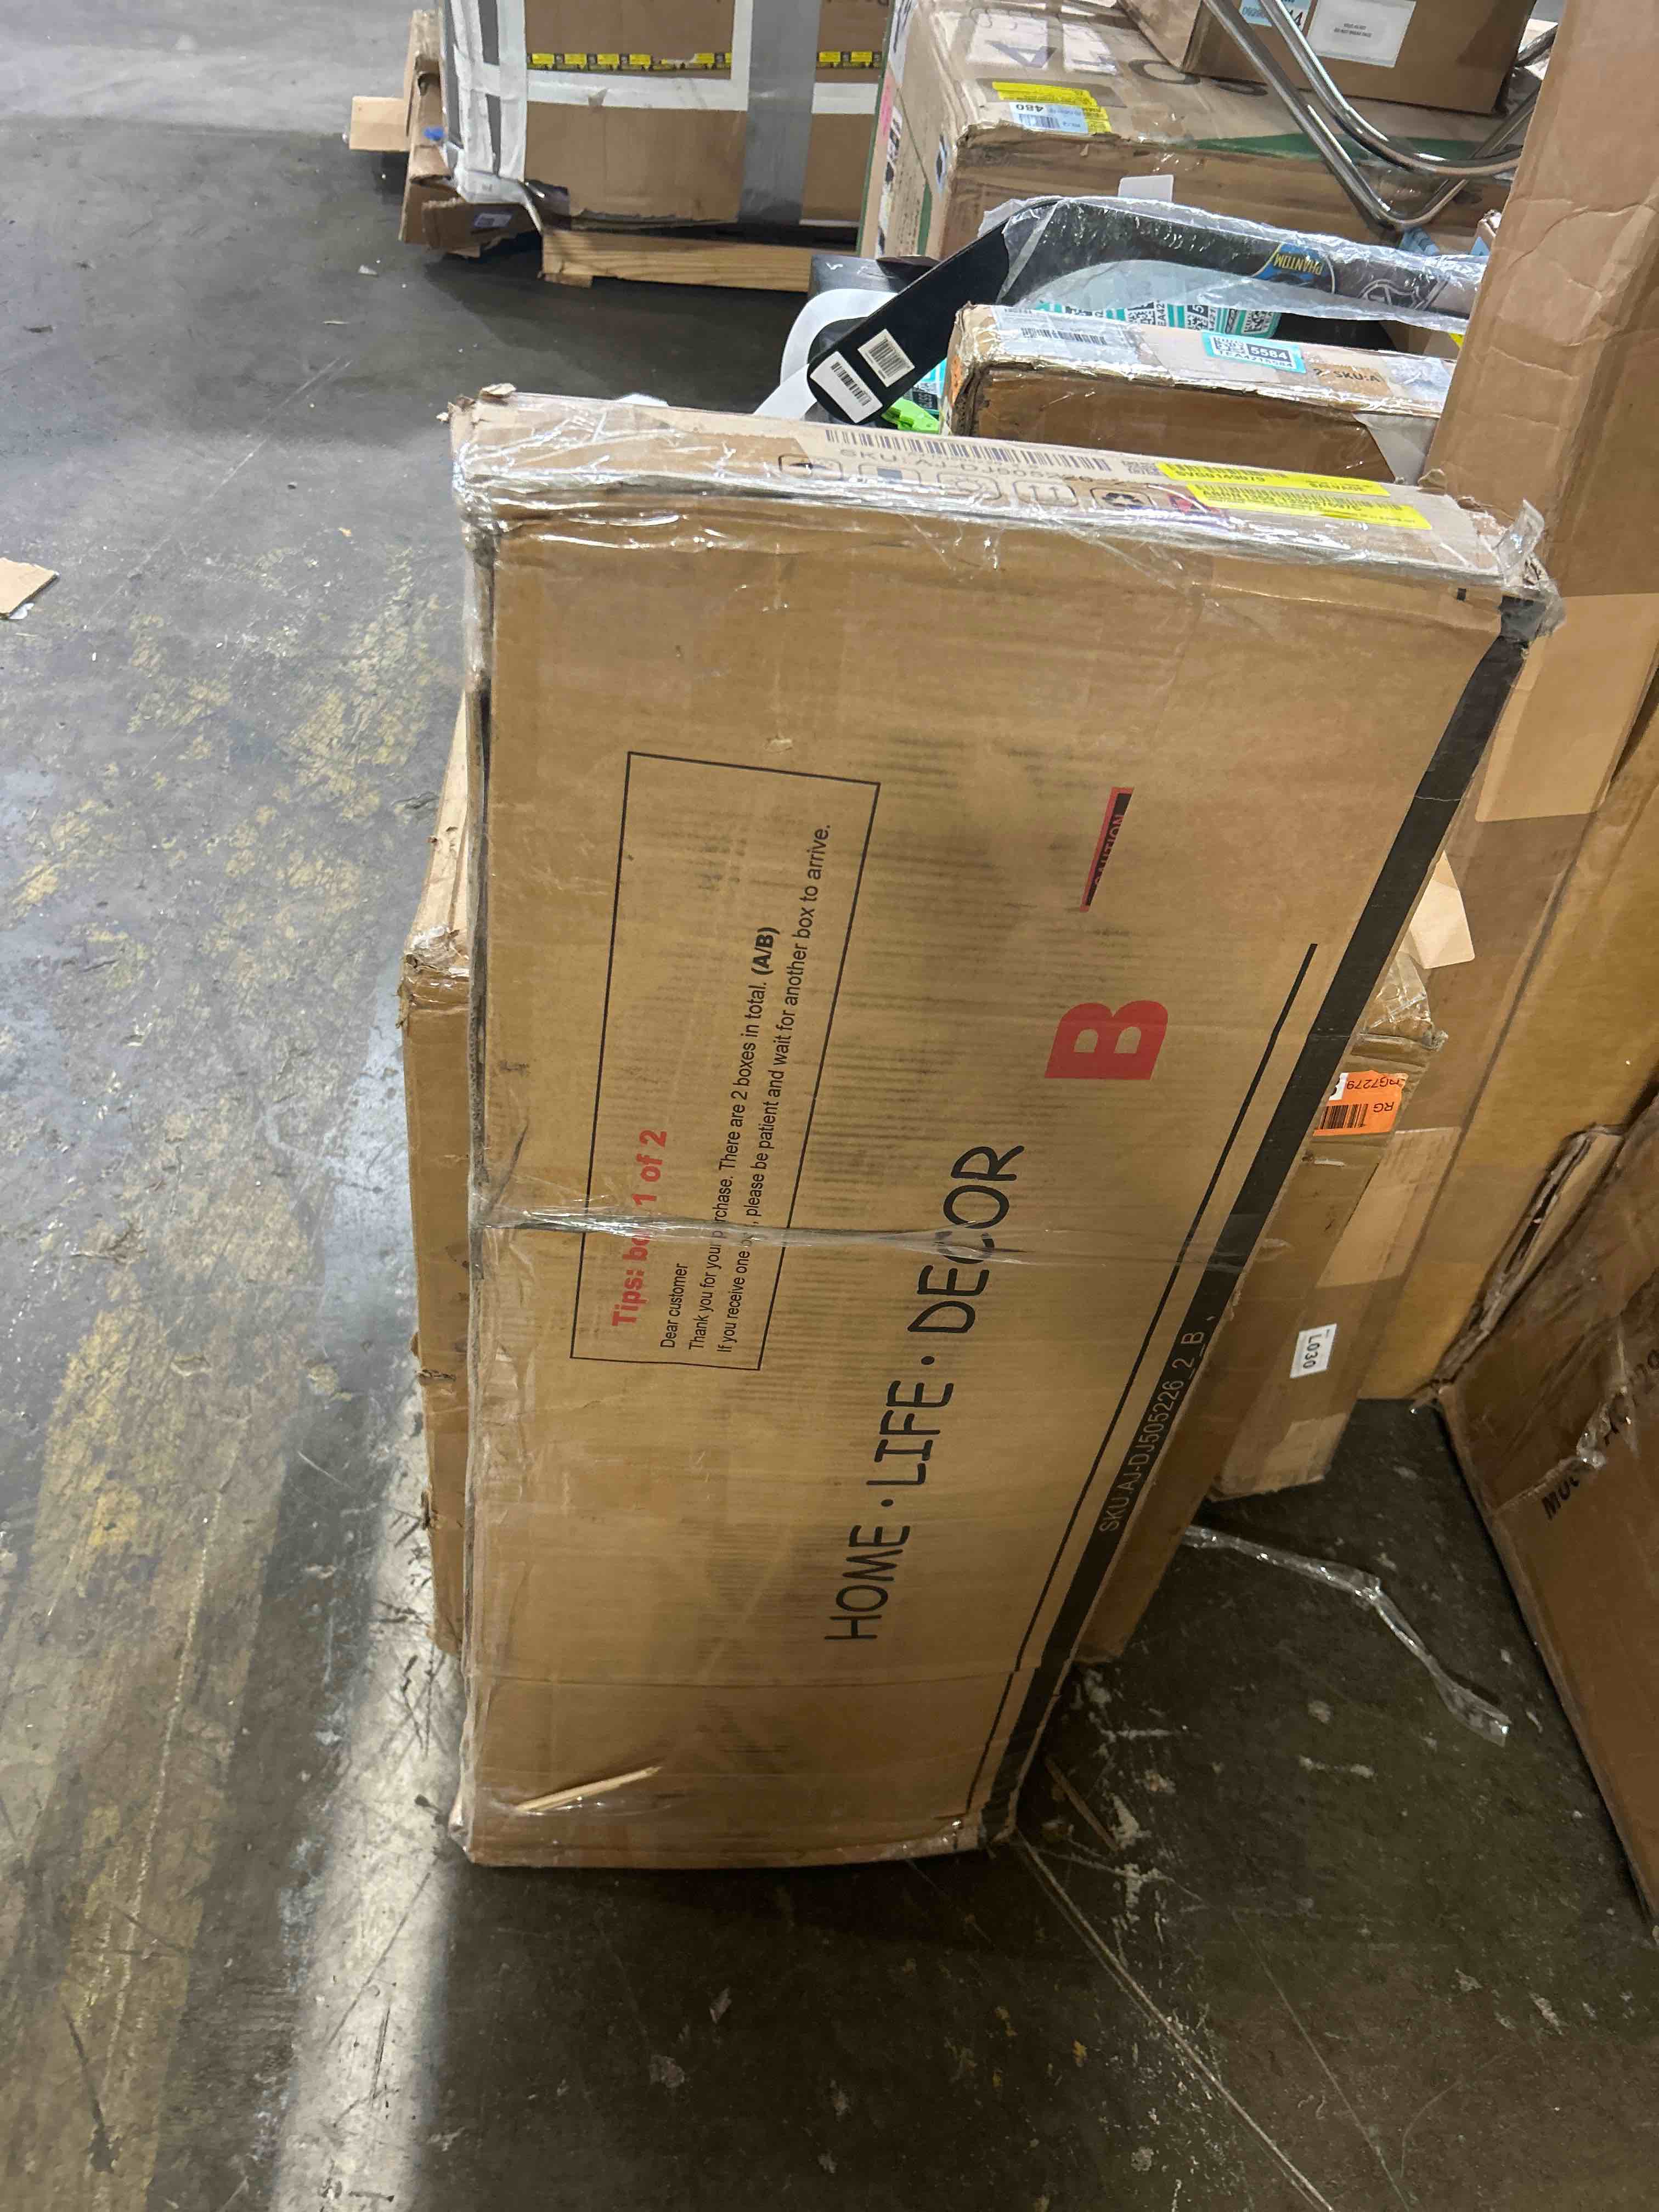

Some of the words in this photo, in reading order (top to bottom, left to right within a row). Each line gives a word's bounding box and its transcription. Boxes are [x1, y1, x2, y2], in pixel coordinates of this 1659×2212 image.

[1016, 103, 1045, 113] 480
[1273, 253, 1323, 276] PHANTOM
[1250, 346, 1289, 360] 5584
[806, 825, 831, 880] arrive.
[798, 885, 819, 902] to
[791, 907, 815, 939] box
[751, 927, 781, 975] (A/B)
[784, 943, 808, 1006] another
[744, 982, 767, 1019] total.
[740, 1024, 760, 1037] in
[775, 1009, 795, 1031] for
[772, 1035, 792, 1065] wait
[1045, 1001, 1167, 1079] B
[732, 1042, 757, 1087] boxes
[730, 1090, 748, 1101] 2
[768, 1069, 785, 1098] and
[730, 1104, 746, 1127] are
[1373, 1101, 1395, 1113] RG
[640, 1130, 668, 1148] 2
[757, 1101, 780, 1149] patient
[718, 1131, 741, 1171] There
[749, 1153, 769, 1170] be
[636, 1153, 663, 1182] of
[632, 1193, 657, 1207] 1
[711, 1176, 734, 1239] prchase.
[743, 1173, 765, 1217] please
[623, 1232, 652, 1260] bo
[907, 1144, 1024, 1334] DECOR
[735, 1250, 751, 1274] one
[668, 1262, 688, 1317] customer
[699, 1271, 717, 1288] for
[612, 1268, 646, 1326] Tips:
[698, 1291, 714, 1312] you
[726, 1277, 746, 1319] receive
[660, 1319, 681, 1348] Dear
[688, 1314, 710, 1350] Thank
[722, 1322, 738, 1344] you
[716, 1344, 732, 1353] If
[1302, 1334, 1322, 1369] L030
[867, 1381, 953, 1485] LIFE
[824, 1525, 910, 1640] HOME
